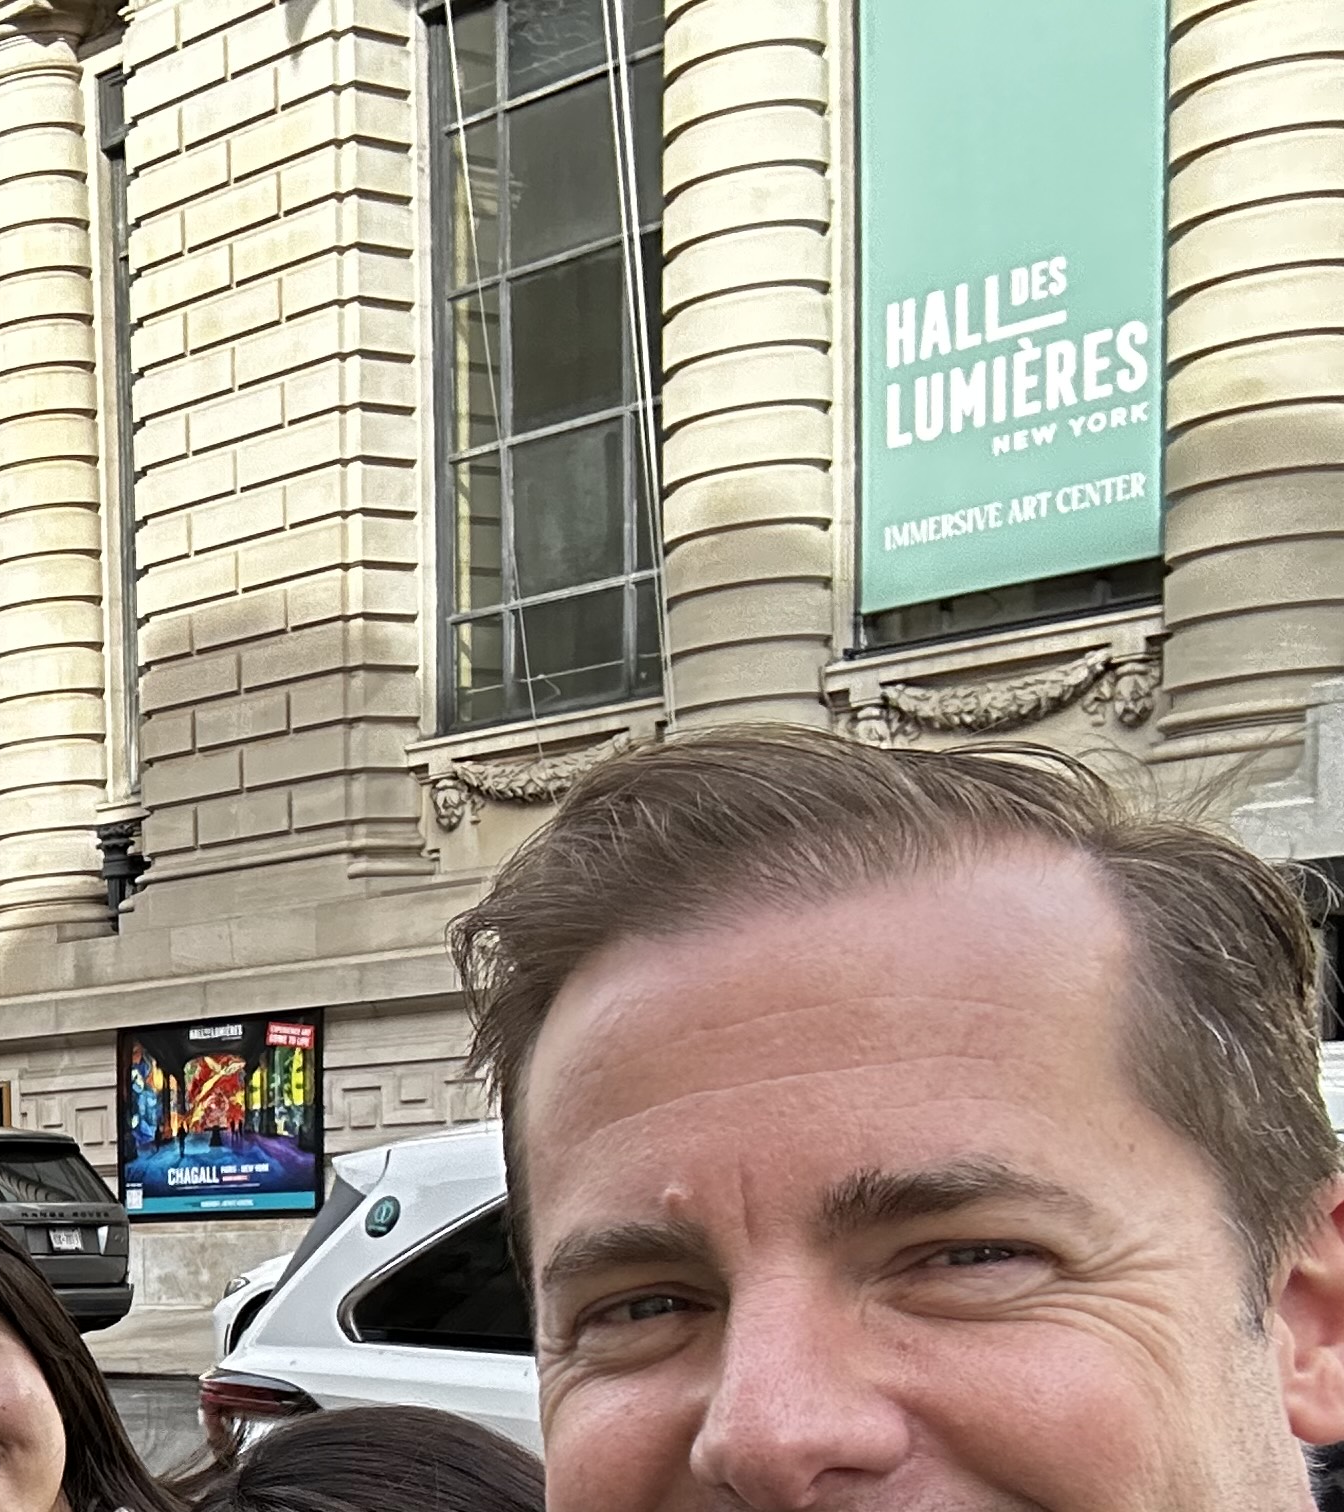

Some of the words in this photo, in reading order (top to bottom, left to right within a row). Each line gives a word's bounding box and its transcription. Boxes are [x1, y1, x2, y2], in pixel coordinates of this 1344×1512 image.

[886, 275, 1067, 370] HALL
[1011, 255, 1067, 307] DES
[886, 320, 1149, 449] LUMIÈRES
[992, 423, 1058, 457] NEW
[1068, 402, 1150, 437] YORK
[884, 502, 1004, 552] IMMERSIVE
[1007, 488, 1053, 525] ART
[1054, 471, 1148, 513] CENTER
[167, 1165, 220, 1186] CHAGALL
